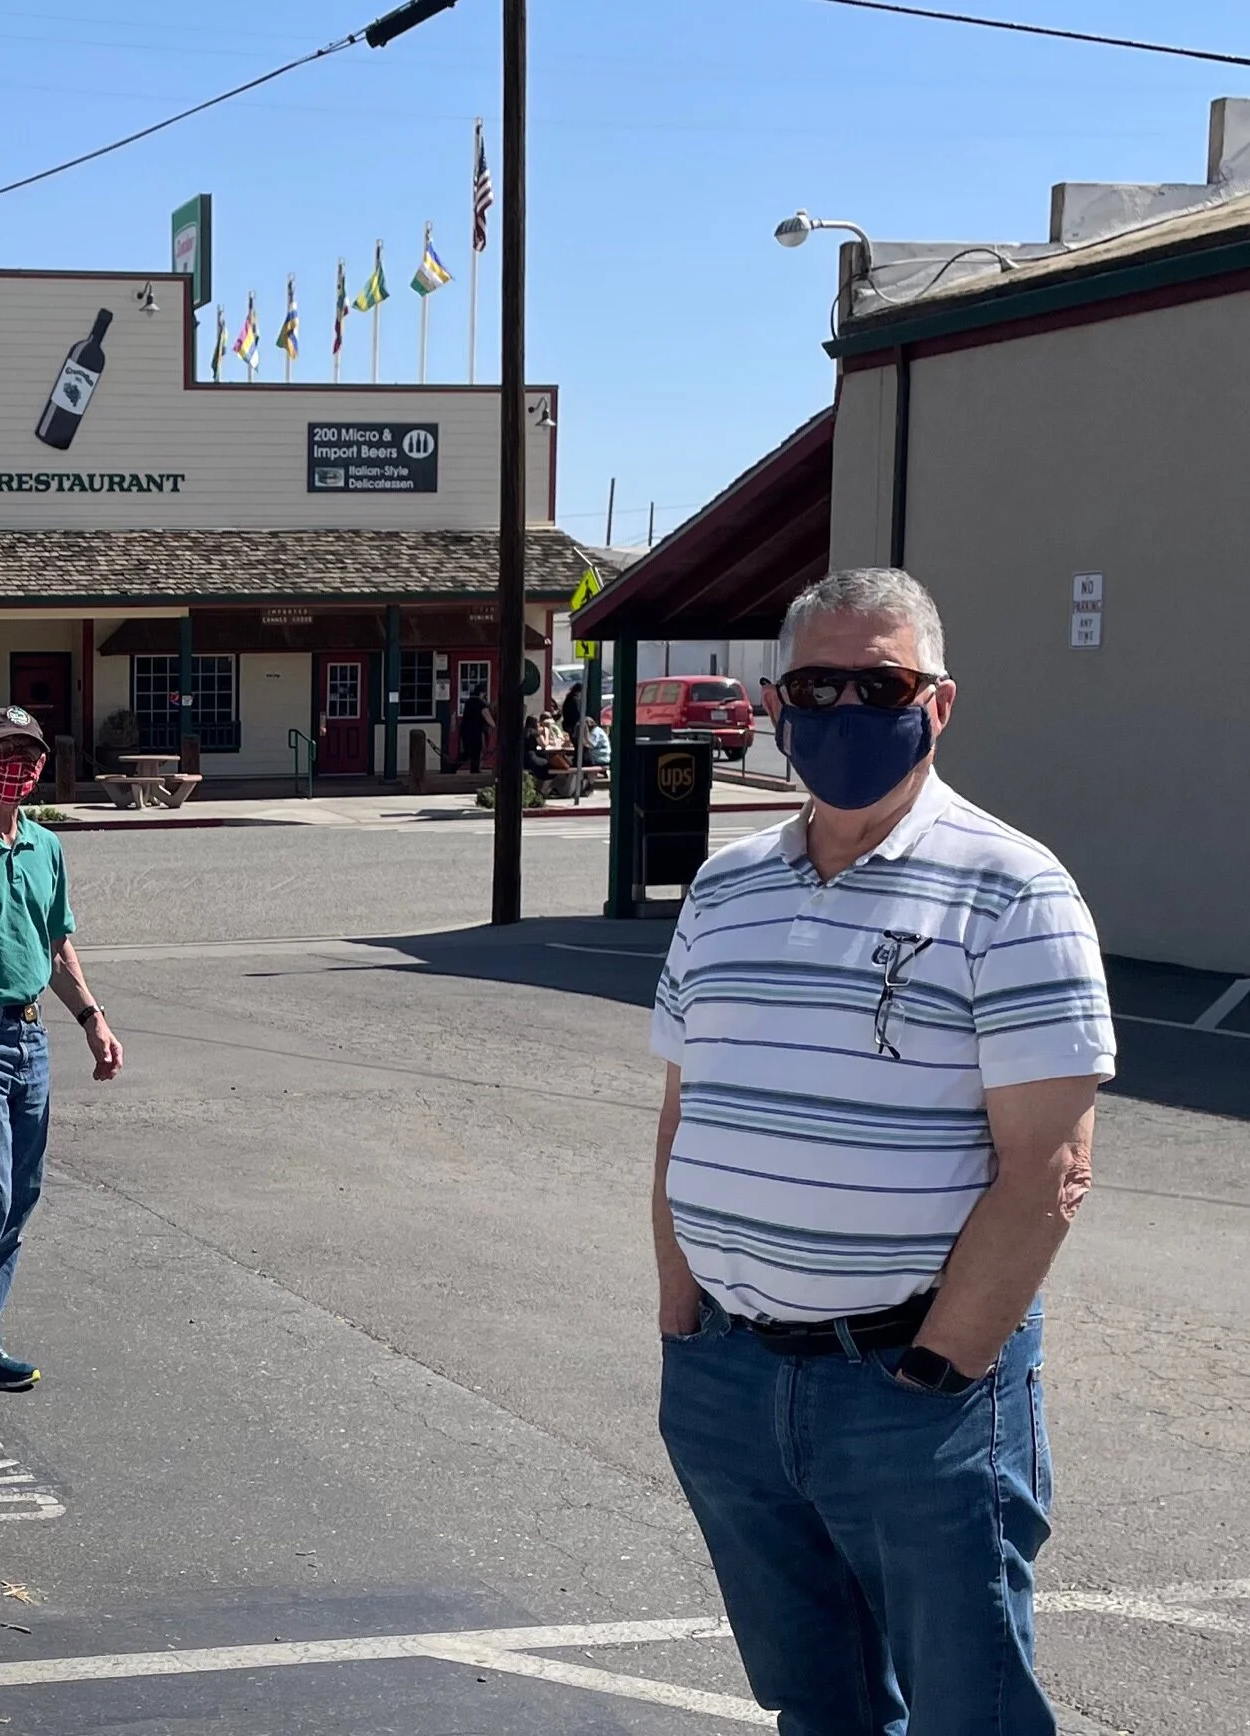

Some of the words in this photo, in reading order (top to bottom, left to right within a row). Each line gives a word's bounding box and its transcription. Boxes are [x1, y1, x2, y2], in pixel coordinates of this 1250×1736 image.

[313, 428, 338, 441] 200
[341, 428, 380, 441] Micro
[382, 428, 392, 441] &
[313, 445, 357, 460] Import
[361, 445, 398, 459] Beers
[349, 466, 409, 477] Italian-Style
[348, 479, 414, 489] Delicatessen
[1080, 580, 1094, 594] NO
[661, 768, 692, 793] ups
